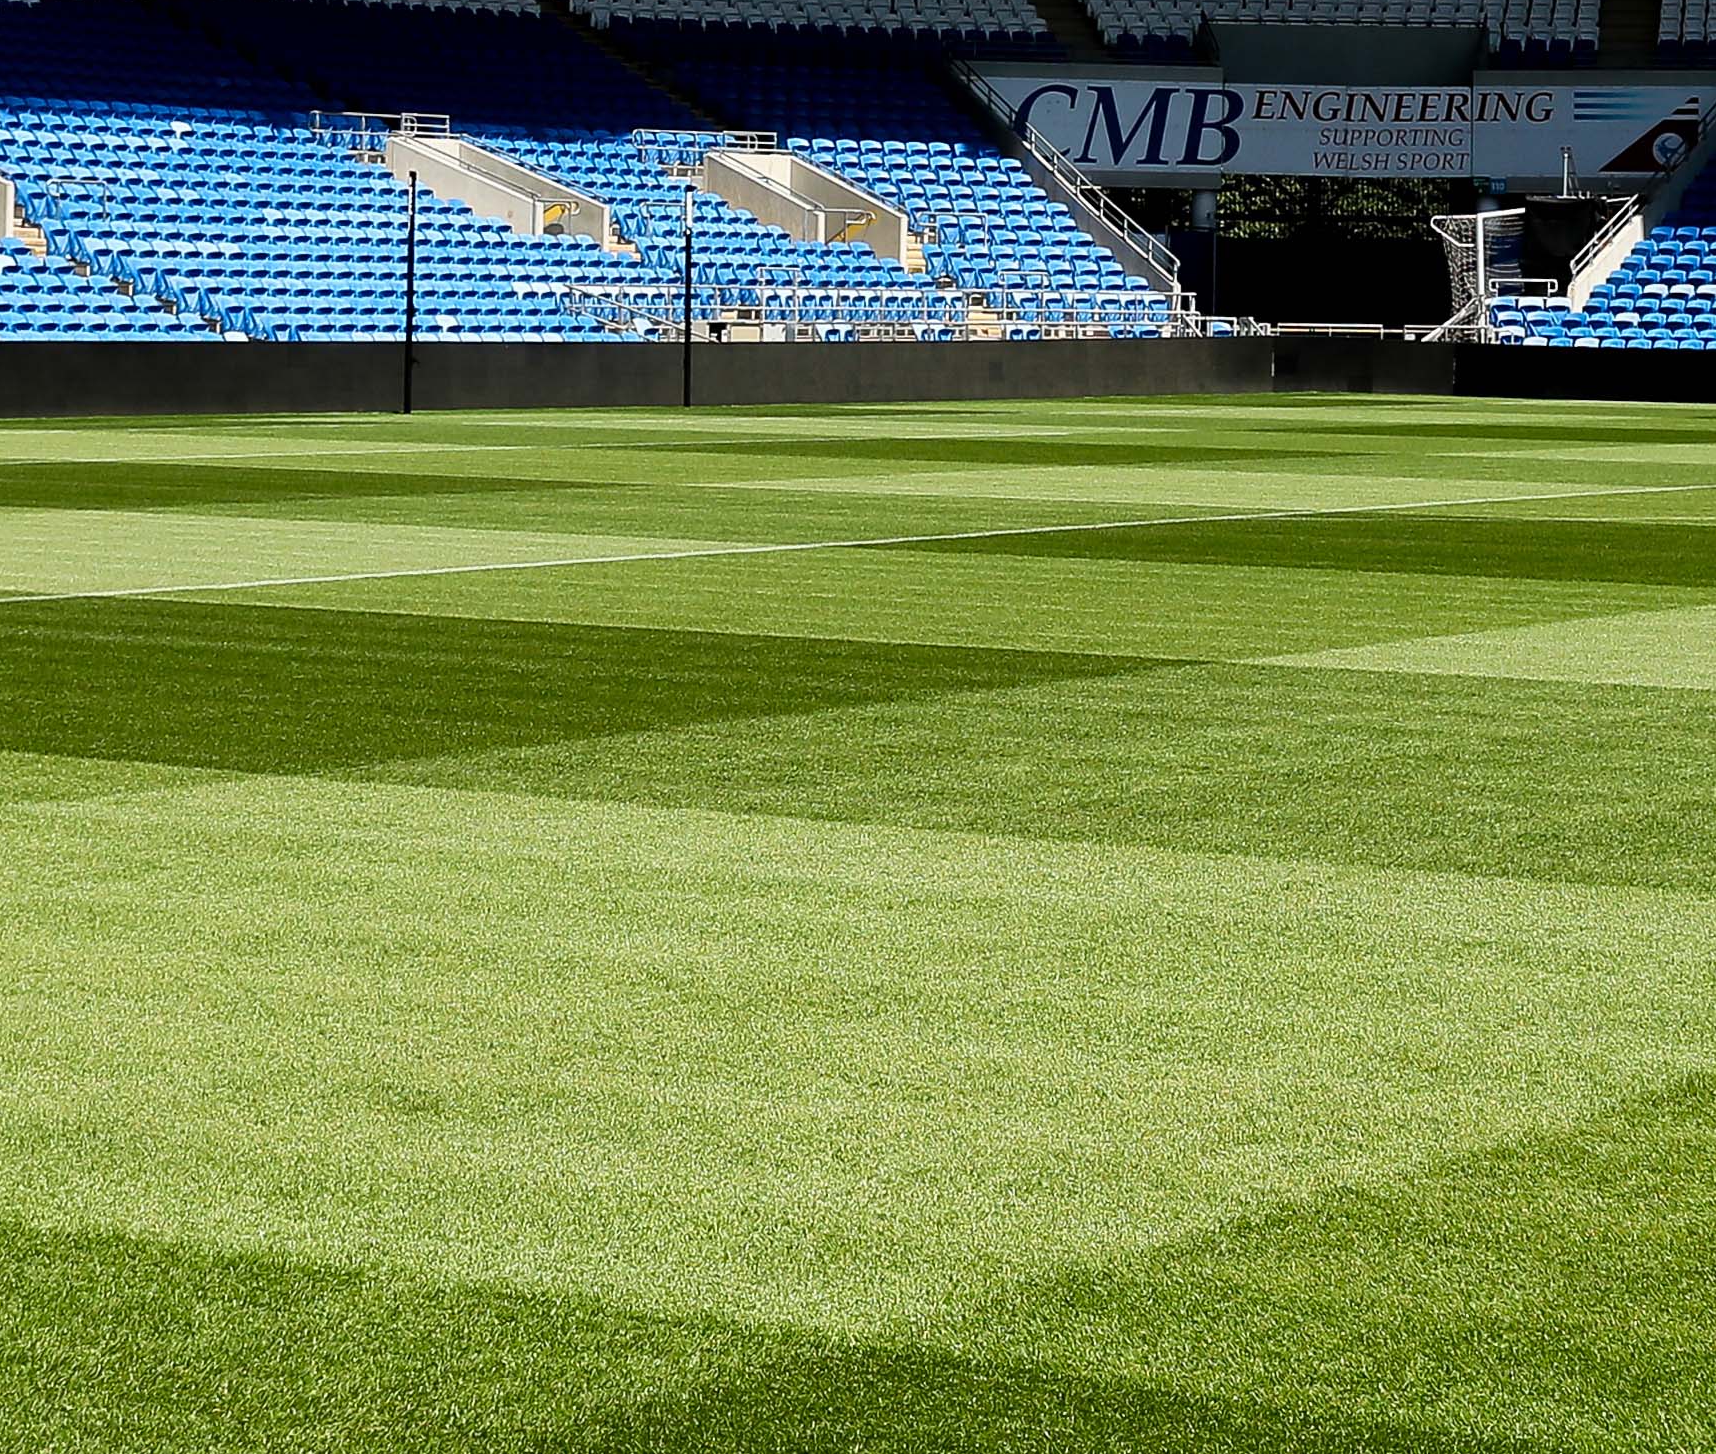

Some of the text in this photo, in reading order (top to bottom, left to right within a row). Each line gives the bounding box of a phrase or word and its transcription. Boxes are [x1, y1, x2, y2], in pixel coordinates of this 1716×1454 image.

[1014, 84, 1555, 165] CMB ENGINEERING
[1319, 128, 1463, 147] SUPPORTING
[1313, 151, 1470, 172] WELSH SPORT
